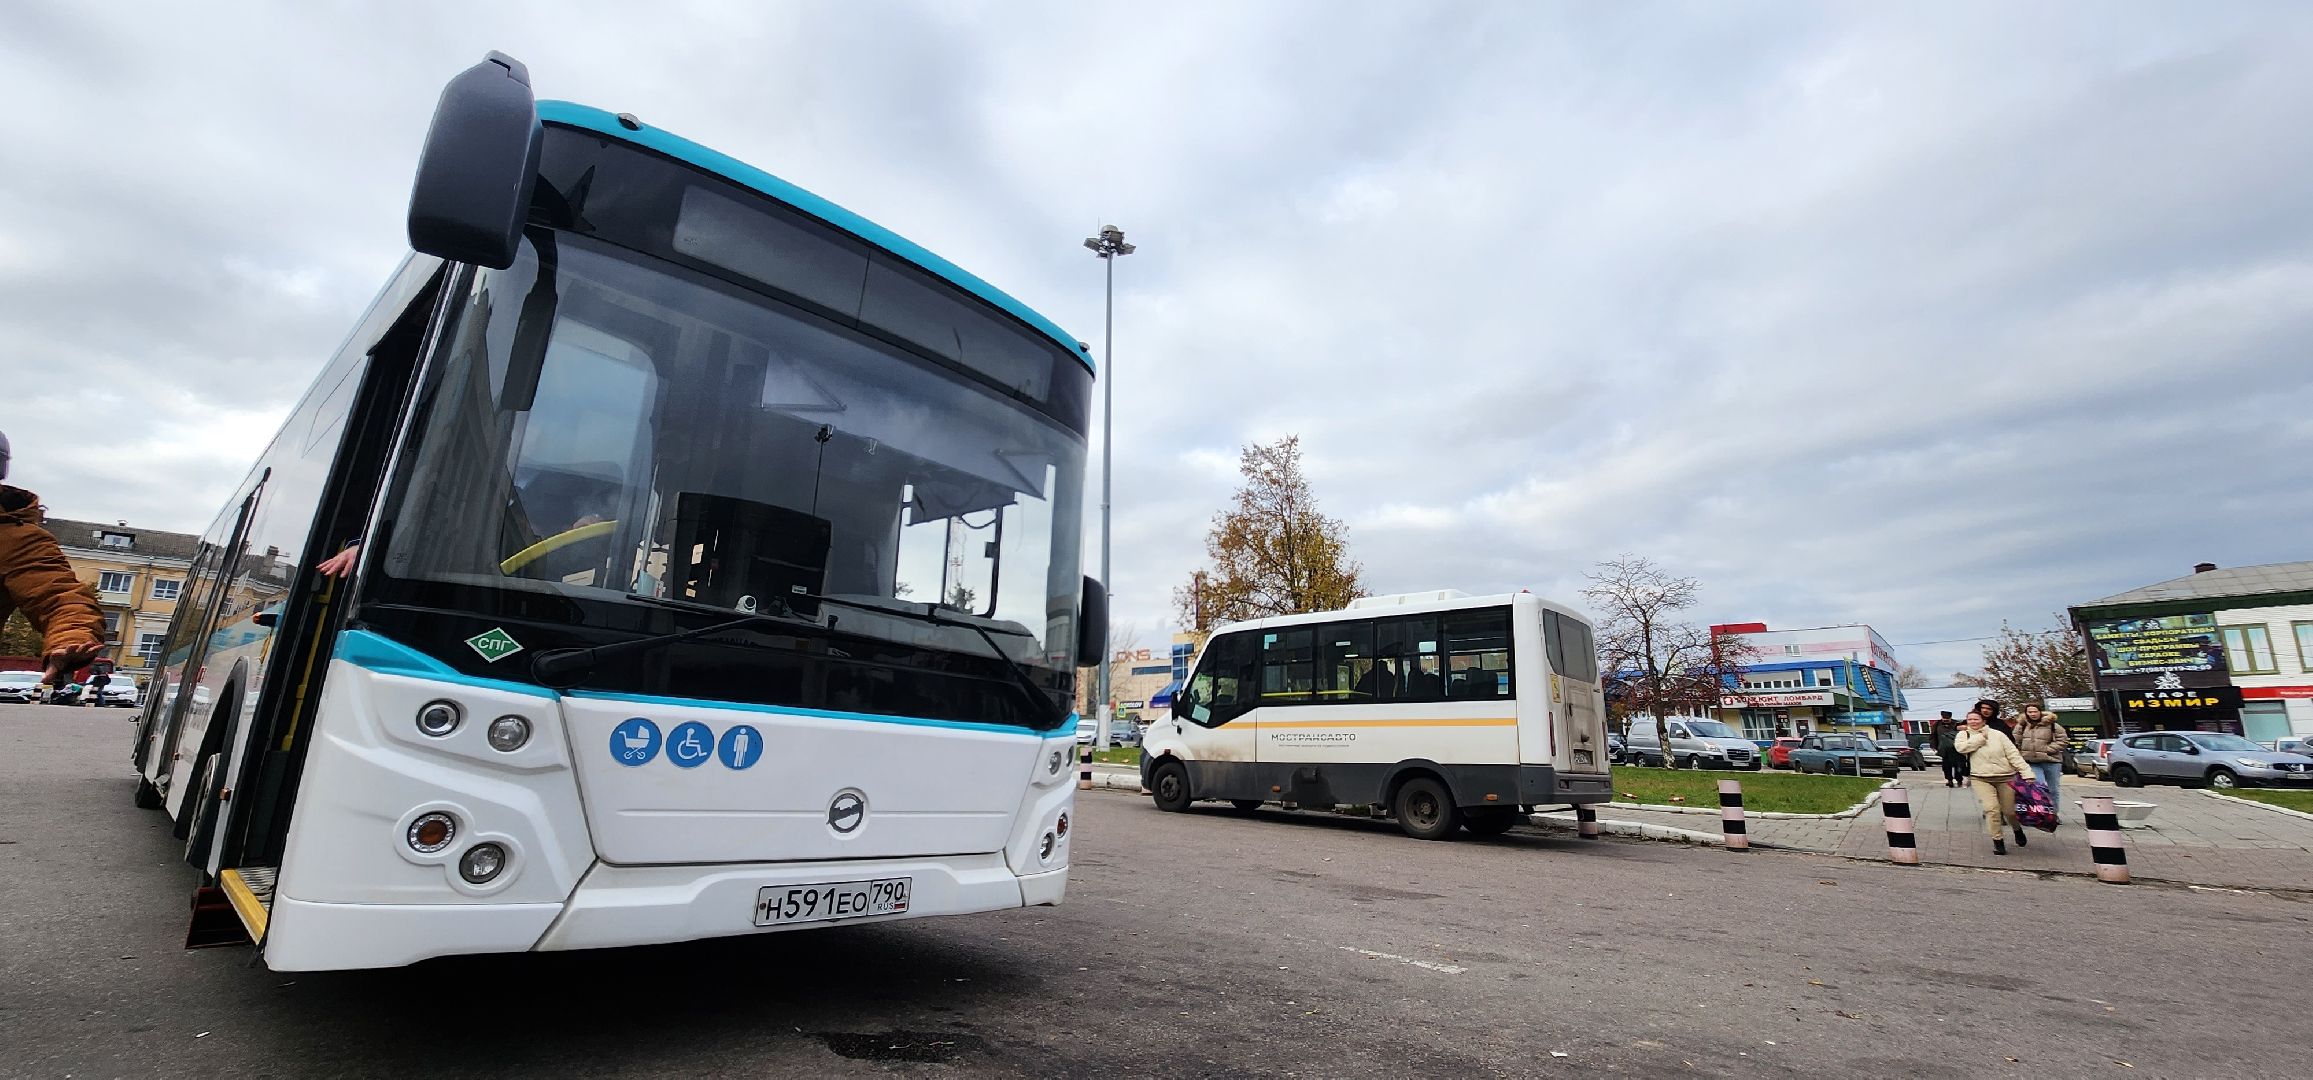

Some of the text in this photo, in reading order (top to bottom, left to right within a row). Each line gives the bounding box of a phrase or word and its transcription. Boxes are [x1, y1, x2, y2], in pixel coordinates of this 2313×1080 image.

[2143, 627, 2215, 637] КОРПОРАТИВЫ
[477, 637, 512, 652] СПГ
[2133, 637, 2179, 645] СВАДЬБЫ
[2137, 651, 2181, 659] КАРАОКЕ
[2128, 697, 2220, 708] ИЗМИР
[1271, 733, 1356, 742] МОСТРАНСАВТО
[872, 881, 905, 904] 790
[877, 902, 894, 911] RUS
